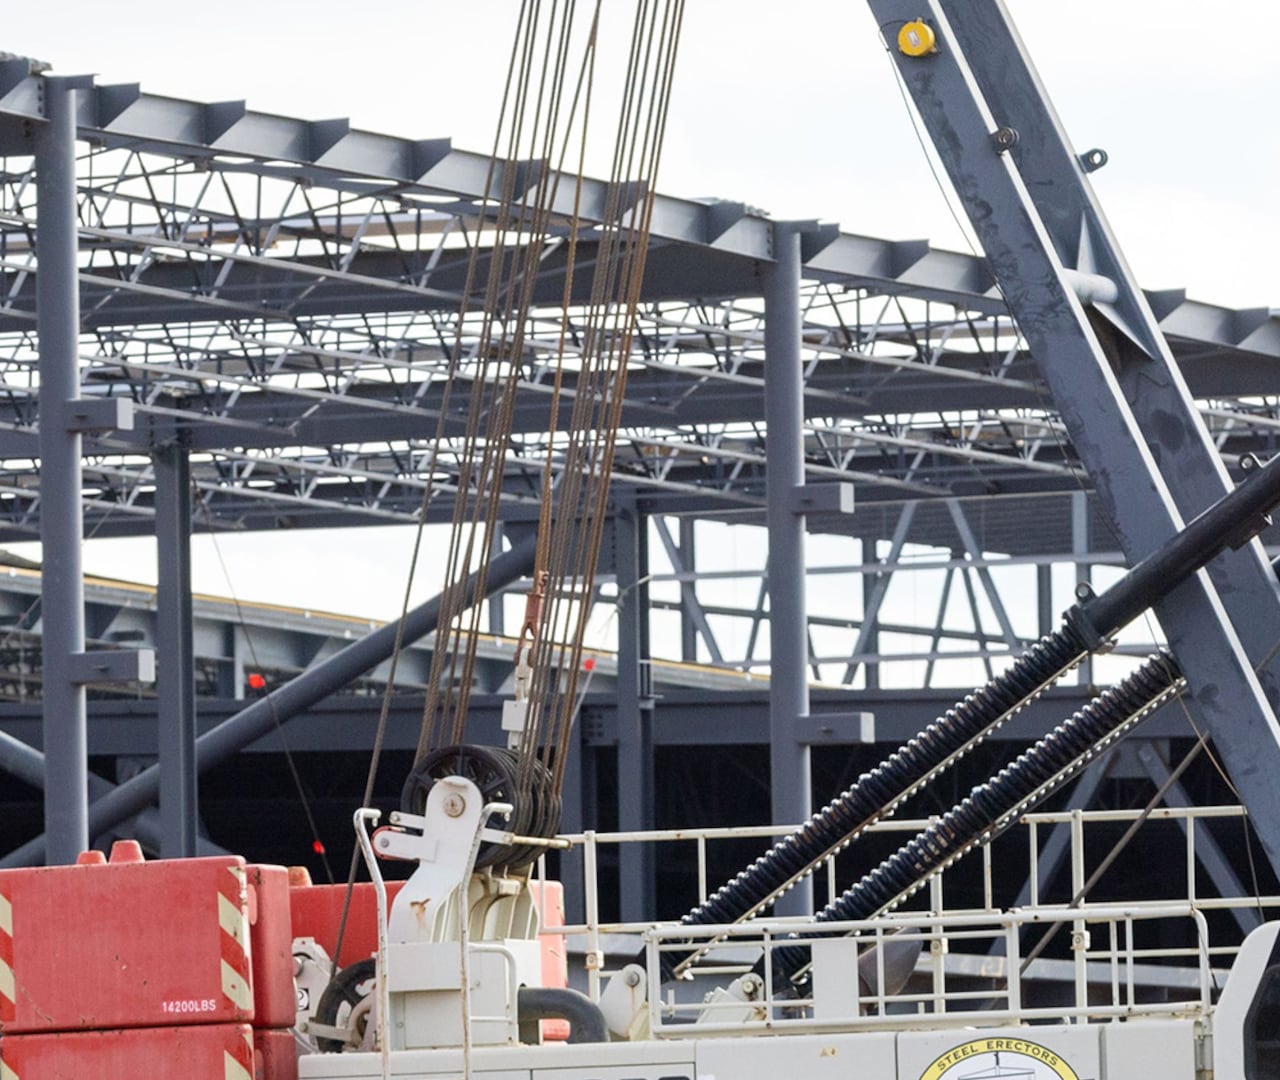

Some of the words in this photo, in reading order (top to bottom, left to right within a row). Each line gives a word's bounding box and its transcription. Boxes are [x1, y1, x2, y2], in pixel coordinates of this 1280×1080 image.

[162, 999, 217, 1013] 14200LBS
[937, 1045, 979, 1071] STEEL
[986, 1039, 1058, 1067] ERECTORS
